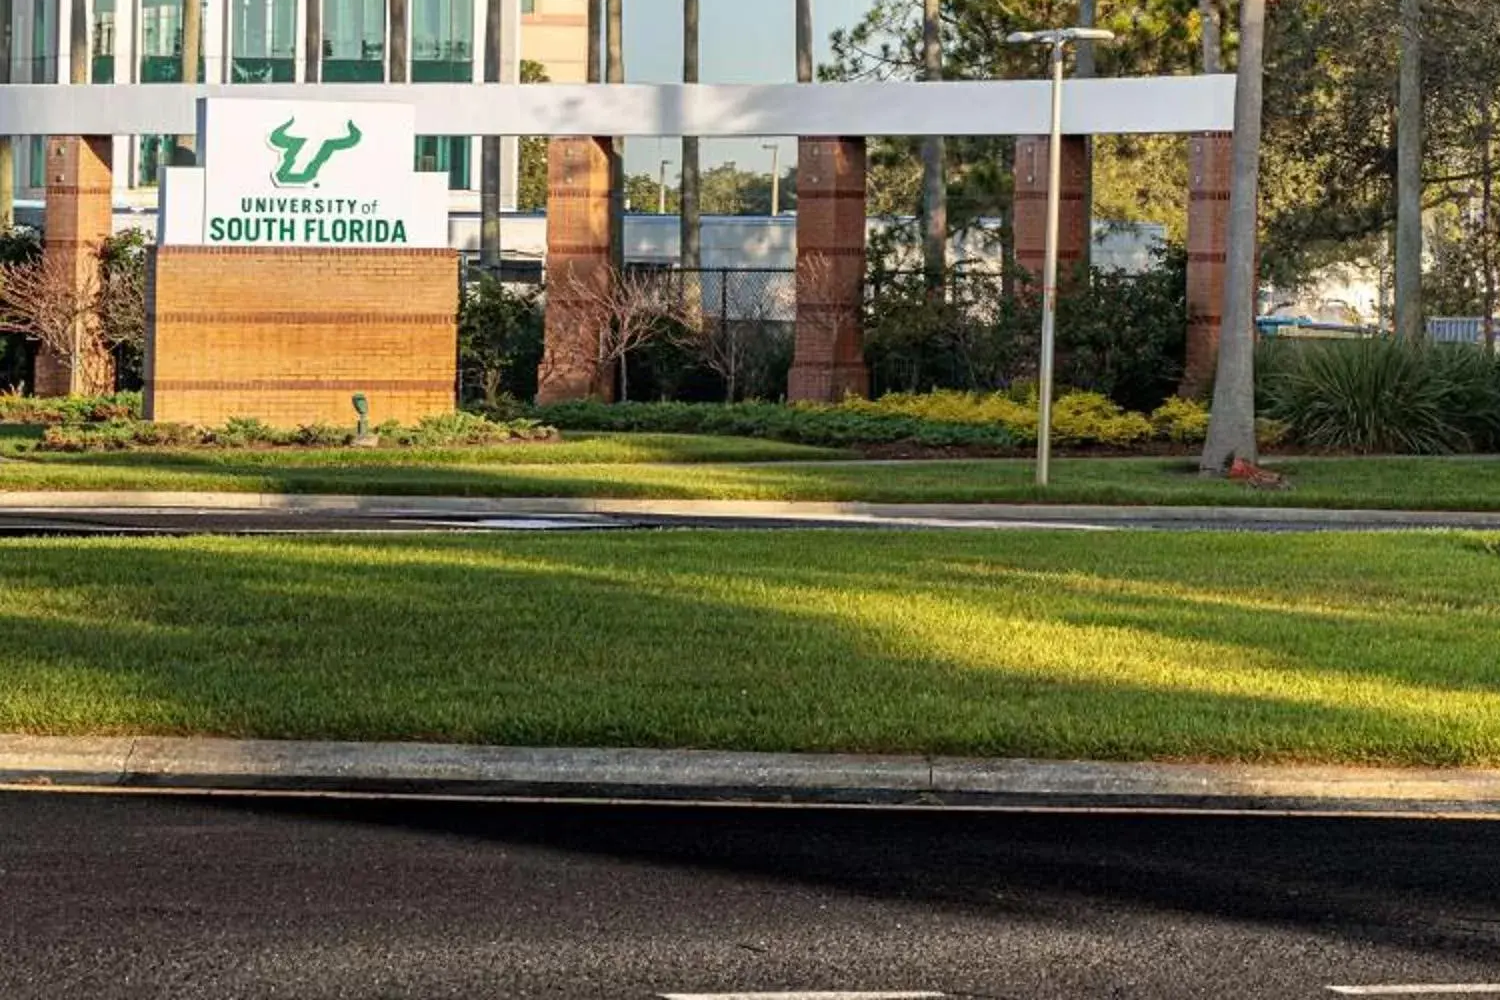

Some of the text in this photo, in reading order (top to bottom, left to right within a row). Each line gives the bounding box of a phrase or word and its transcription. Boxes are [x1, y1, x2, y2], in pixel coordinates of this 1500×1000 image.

[241, 198, 379, 215] UNIVERSITY of
[209, 217, 407, 243] SOUTH FLORIDA
